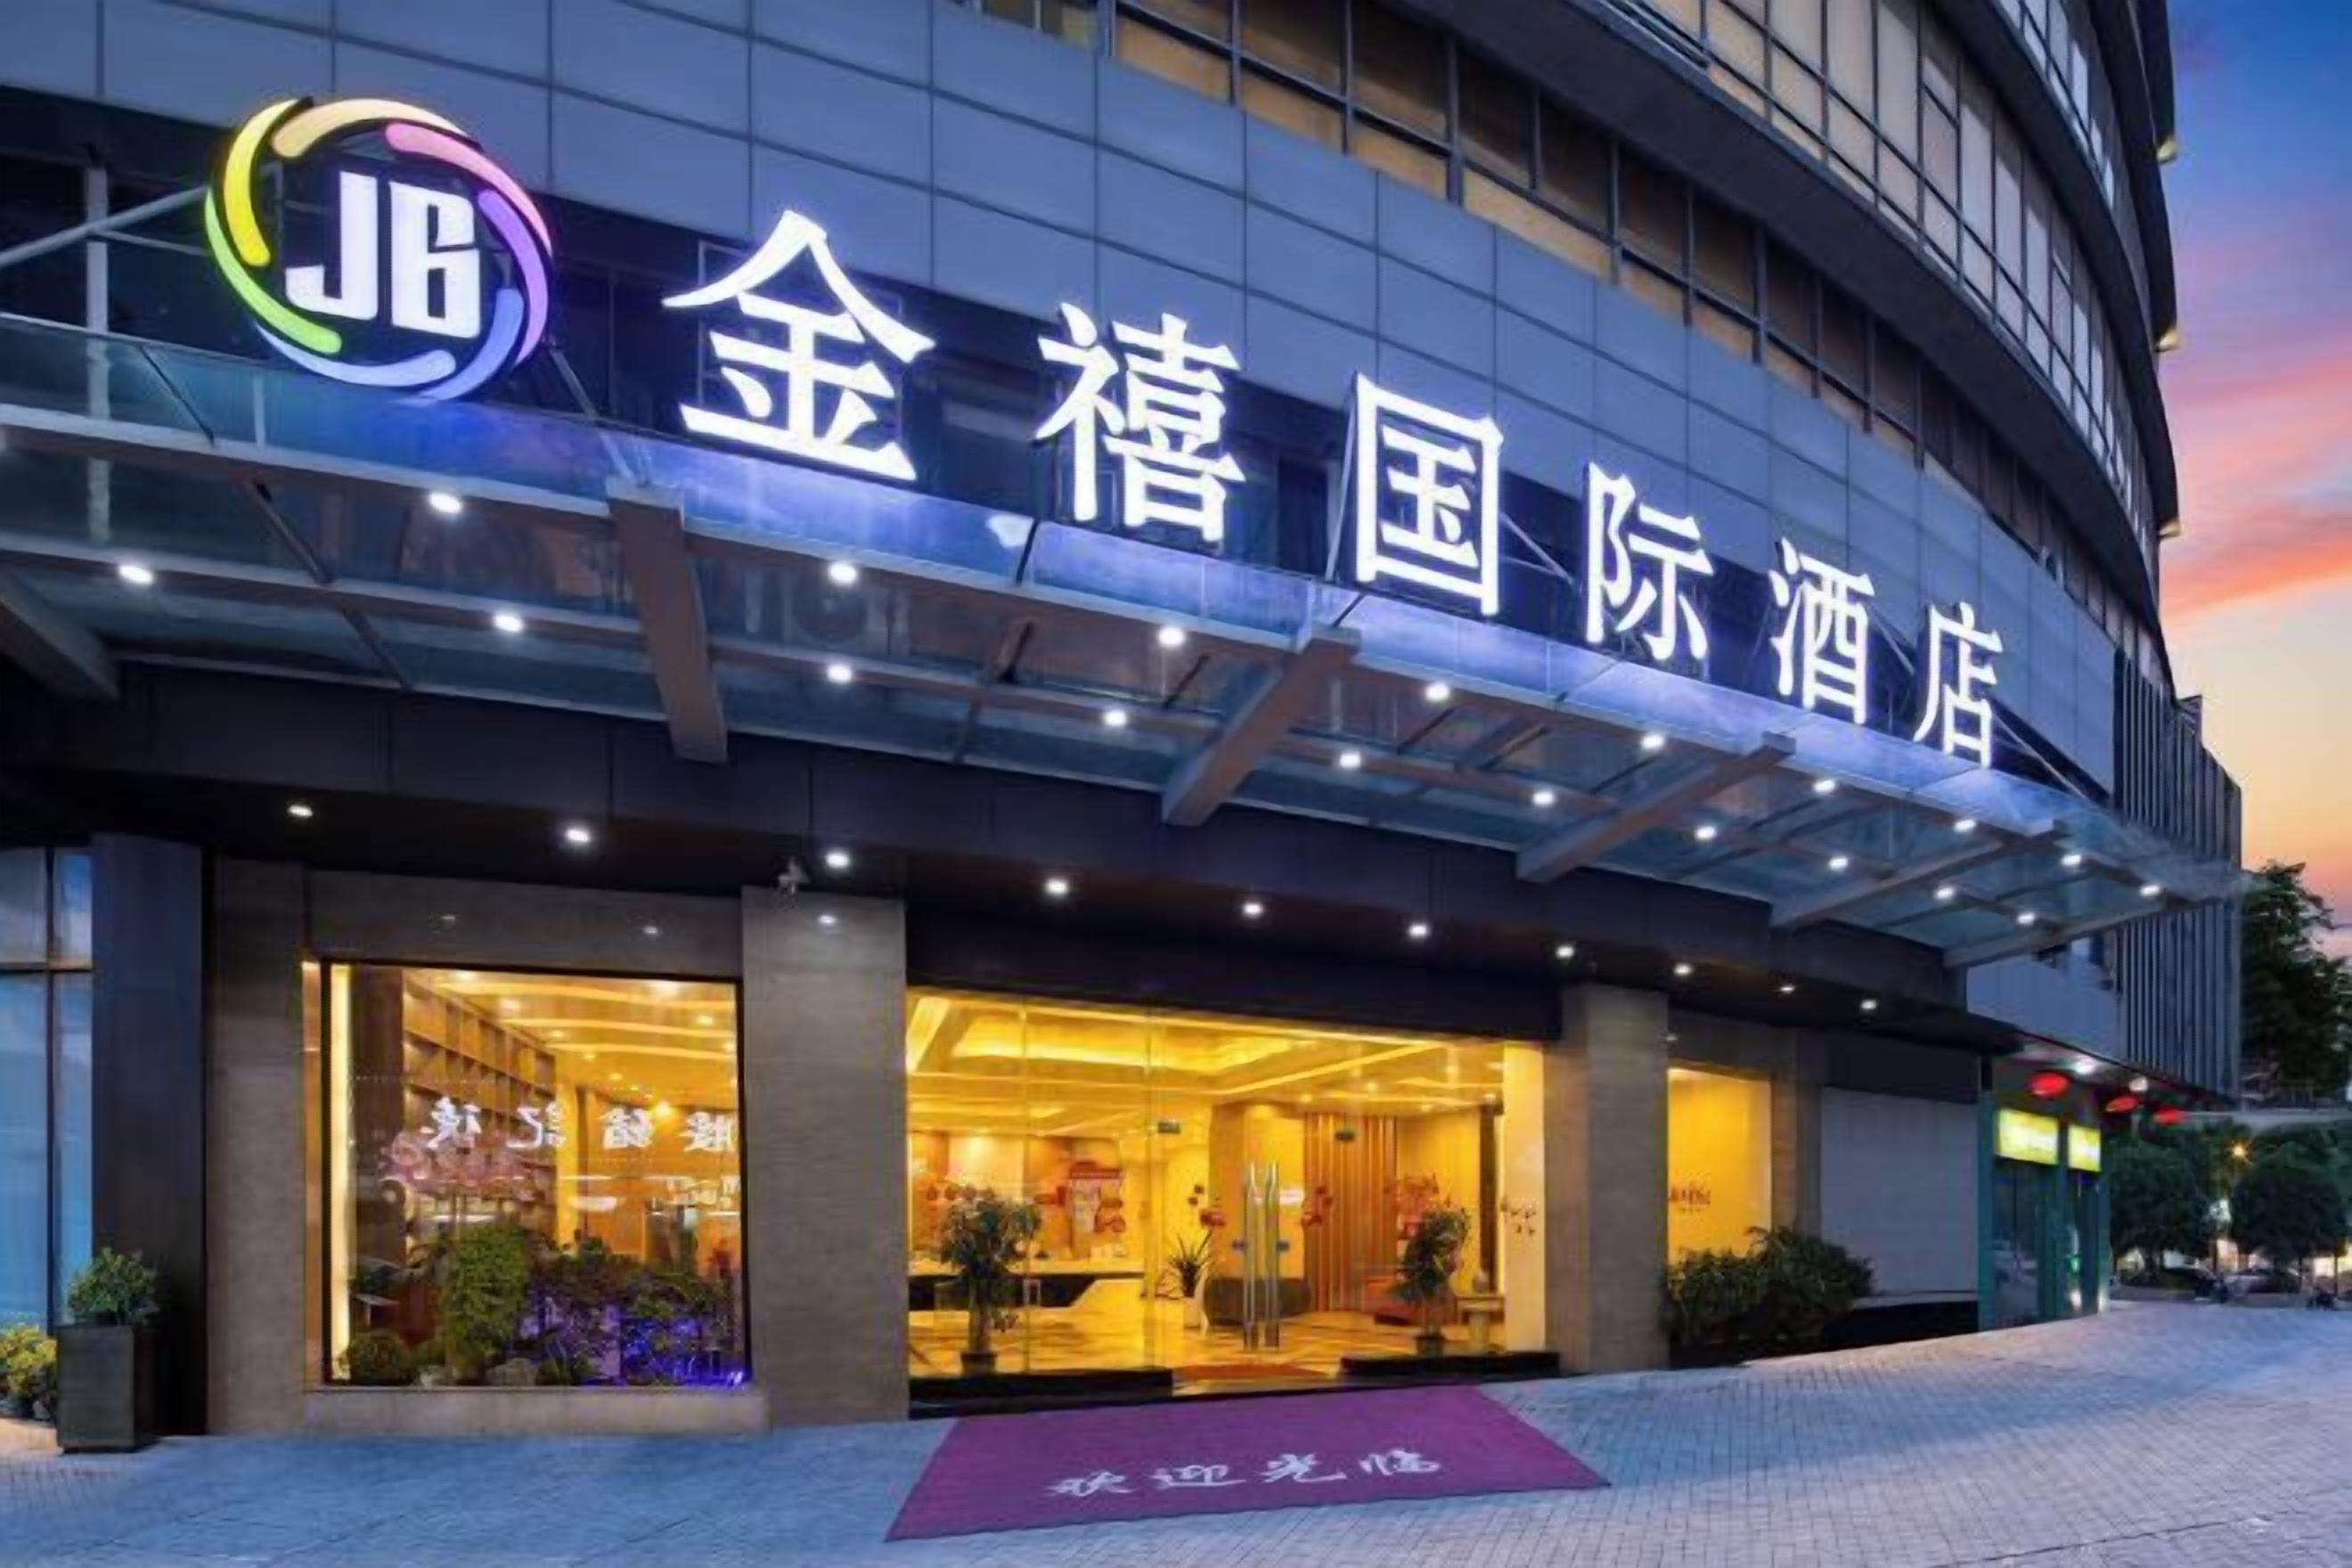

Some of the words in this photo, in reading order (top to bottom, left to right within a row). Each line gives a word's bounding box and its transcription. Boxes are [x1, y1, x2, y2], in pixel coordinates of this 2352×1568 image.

[663, 209, 2004, 769] 金禧国际酒店
[1046, 1449, 1441, 1498] 欢迎光临
